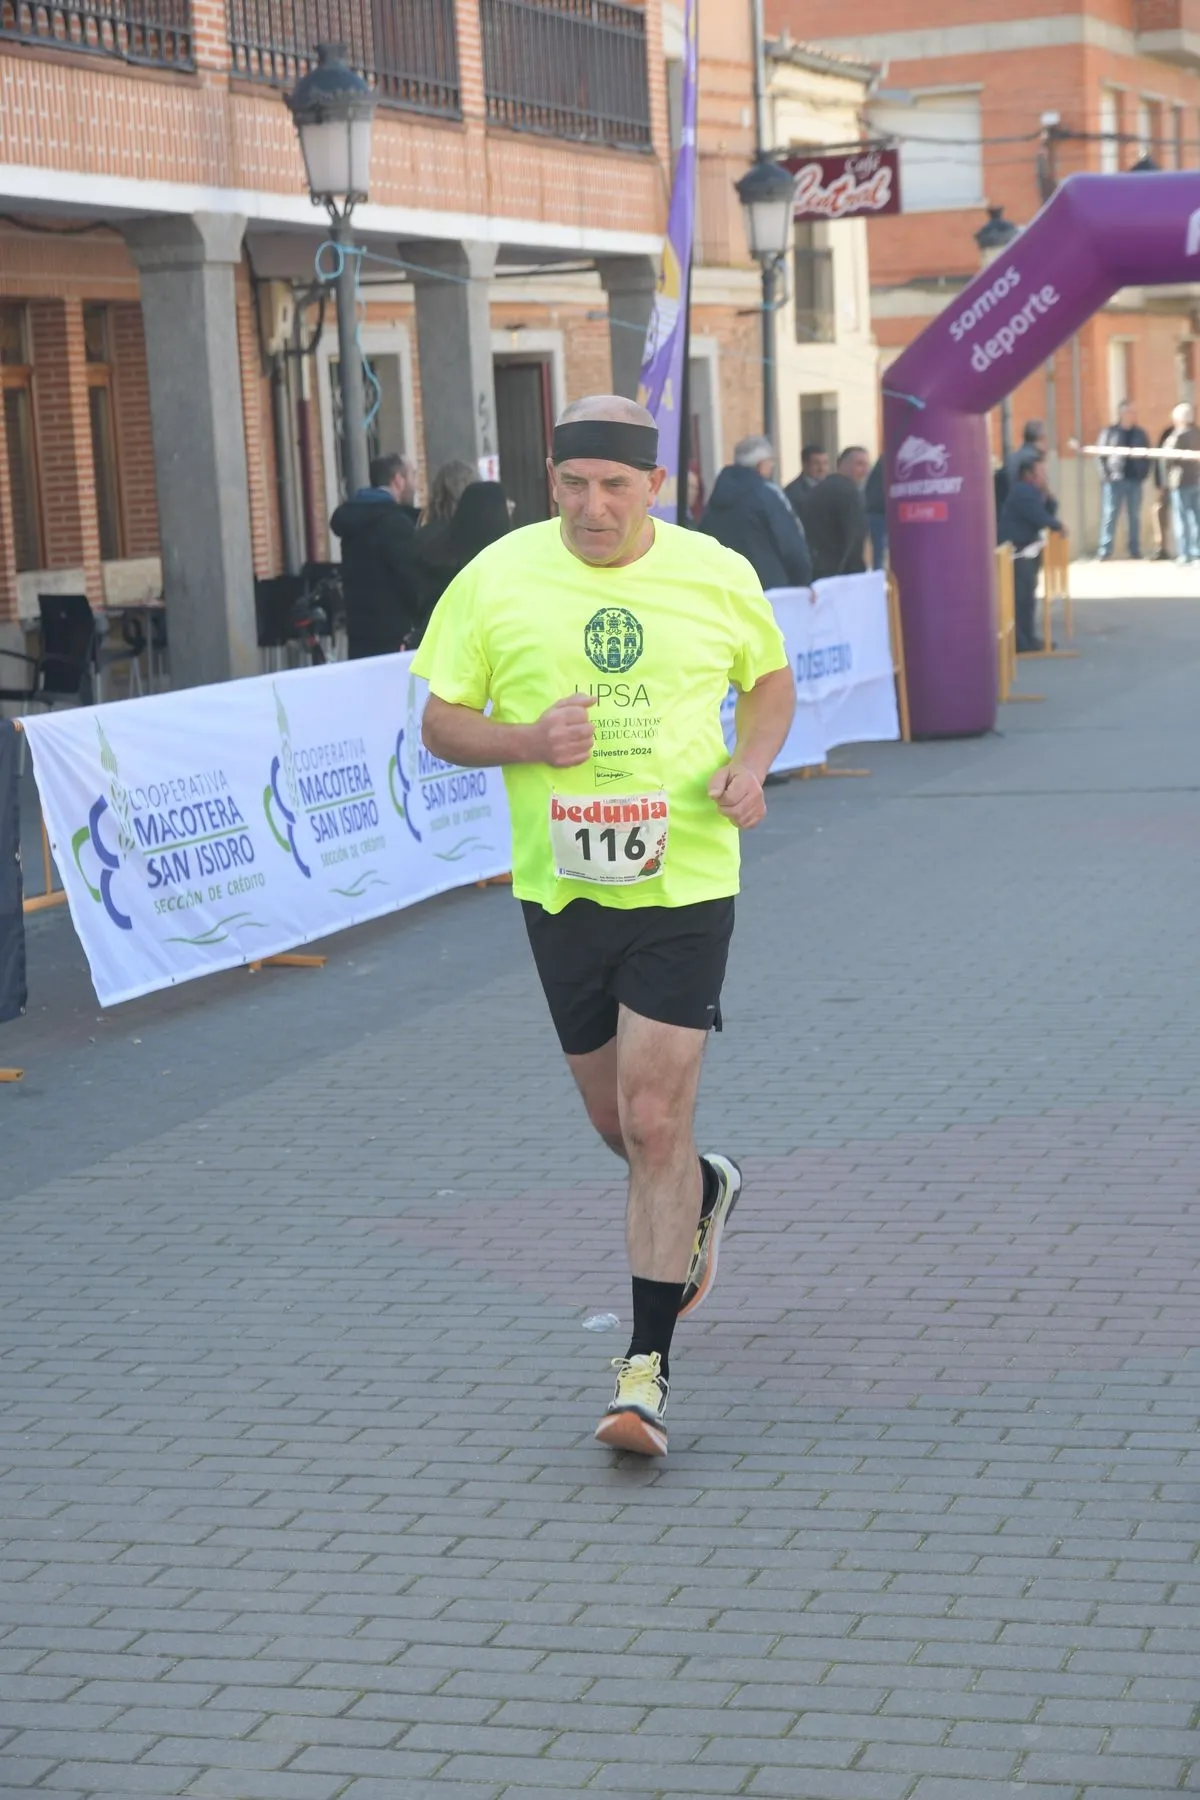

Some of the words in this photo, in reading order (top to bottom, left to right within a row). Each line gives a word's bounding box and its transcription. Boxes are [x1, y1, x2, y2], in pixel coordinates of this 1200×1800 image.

[949, 265, 1020, 342] somos
[971, 284, 1061, 372] deporte
[623, 716, 662, 728] JUNTOS
[293, 737, 366, 773] COOPERATIVA
[593, 749, 629, 758] Silvestre
[630, 747, 652, 756] 2024
[128, 769, 231, 811] COOPERATIVA
[298, 762, 373, 807] MACOTERA
[421, 781, 446, 811] SAN
[448, 770, 487, 804] ISIDRO
[133, 795, 244, 848] MACOTERA
[310, 809, 340, 844] SAN
[339, 799, 379, 835] ISIDRO
[551, 798, 667, 824] bedunia
[147, 849, 191, 889] SAN
[195, 833, 255, 878] ISIDRO
[575, 826, 646, 862] 116
[153, 887, 203, 915] SECCIÓN
[208, 884, 223, 901] DE
[227, 872, 266, 896] CRÉDITO
